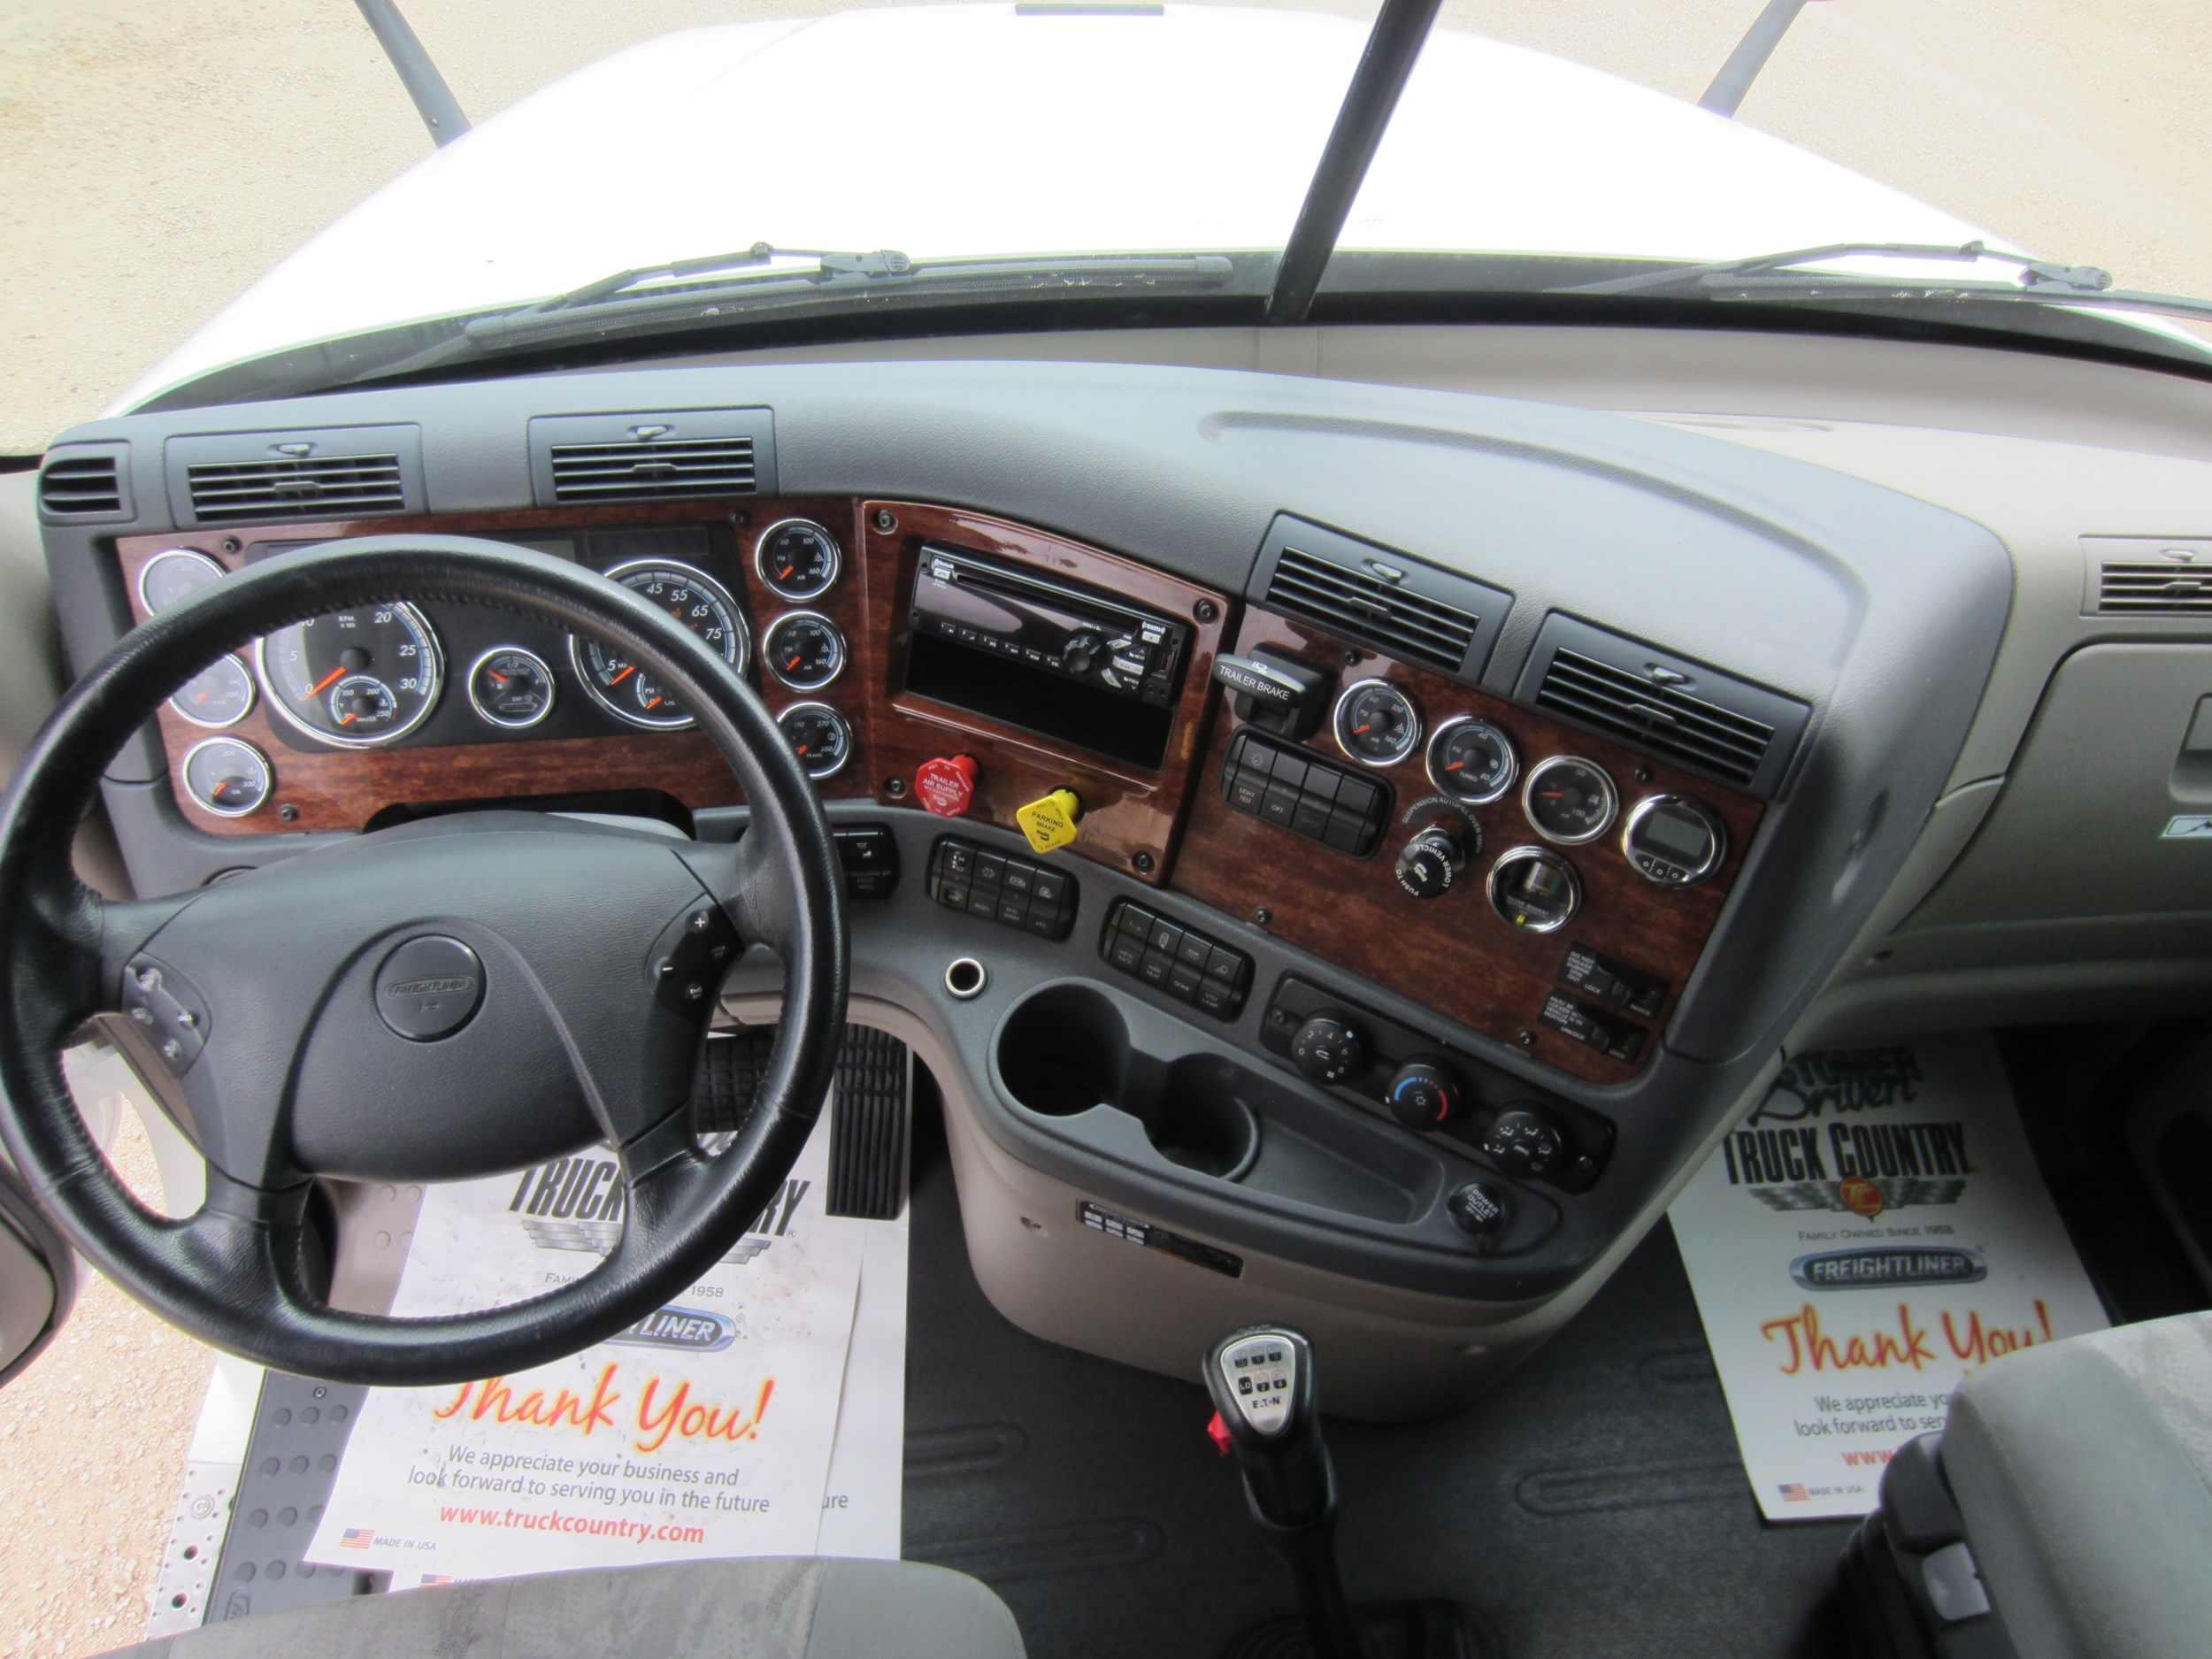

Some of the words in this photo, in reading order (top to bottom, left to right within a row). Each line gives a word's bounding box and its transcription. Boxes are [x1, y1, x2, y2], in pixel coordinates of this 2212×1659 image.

[646, 583, 664, 595] 45
[670, 589, 688, 602] 55
[374, 611, 392, 624] 20
[691, 604, 709, 617] 65
[705, 627, 723, 640] 75
[289, 650, 298, 662] 5
[400, 645, 417, 657] 25
[607, 659, 617, 672] 5
[304, 683, 314, 695] 0
[400, 678, 418, 690] 30
[1219, 664, 1256, 688] TRAILER
[1256, 681, 1290, 701] BRAKE
[930, 772, 959, 788] TRAILER
[936, 783, 963, 797] SUPPLY
[1239, 787, 1256, 797] LIGHT
[1240, 795, 1252, 804] TEST
[1402, 796, 1438, 825] SUSPENSION
[1571, 808, 1586, 818] 100
[1032, 811, 1064, 828] PARKING
[1036, 821, 1056, 832] BRAKE
[1415, 844, 1446, 862] VEHICLE
[1395, 869, 1403, 879] TO
[1442, 860, 1452, 887] LOWER
[1401, 879, 1419, 896] PUSH
[1584, 983, 1601, 994] LOCK
[1307, 1030, 1314, 1040] 2
[1560, 1026, 1586, 1041] UNLOCK
[1337, 1065, 1344, 1074] 8
[1724, 1127, 1826, 1185] TRUCK
[1828, 1122, 1970, 1178] COUNTRY
[1468, 1194, 1494, 1218] OUTLET
[1472, 1189, 1499, 1214] POWER
[1798, 1231, 1837, 1241] FAMILY
[1840, 1229, 1884, 1240] OWNED
[1886, 1226, 1920, 1238] SINCE
[1924, 1225, 1954, 1236] 1958
[1813, 1255, 1967, 1281] FREIGHTLINER
[692, 1286, 724, 1298] 1958
[1761, 1302, 1936, 1375] Thank
[433, 1363, 620, 1436] Thank
[634, 1377, 776, 1453] You!
[1816, 1395, 1842, 1413] We
[1846, 1393, 1926, 1414] appreciate
[1793, 1419, 1832, 1437] look
[1833, 1416, 1896, 1434] forward
[1899, 1417, 1916, 1431] to
[449, 1444, 475, 1466] We
[480, 1451, 574, 1476] appreciate
[577, 1460, 620, 1478] your
[623, 1460, 700, 1484] business
[704, 1469, 739, 1486] and
[408, 1465, 447, 1487] look
[451, 1468, 524, 1494] forward
[528, 1479, 547, 1495] to
[550, 1482, 617, 1506] serving
[619, 1488, 655, 1506] you
[658, 1487, 676, 1505] in
[681, 1490, 710, 1509] the
[714, 1492, 770, 1513] future
[440, 1506, 704, 1544] www.truckcountry.com
[373, 1536, 403, 1548] MADE
[403, 1540, 415, 1549] IN
[418, 1540, 437, 1551] USA
